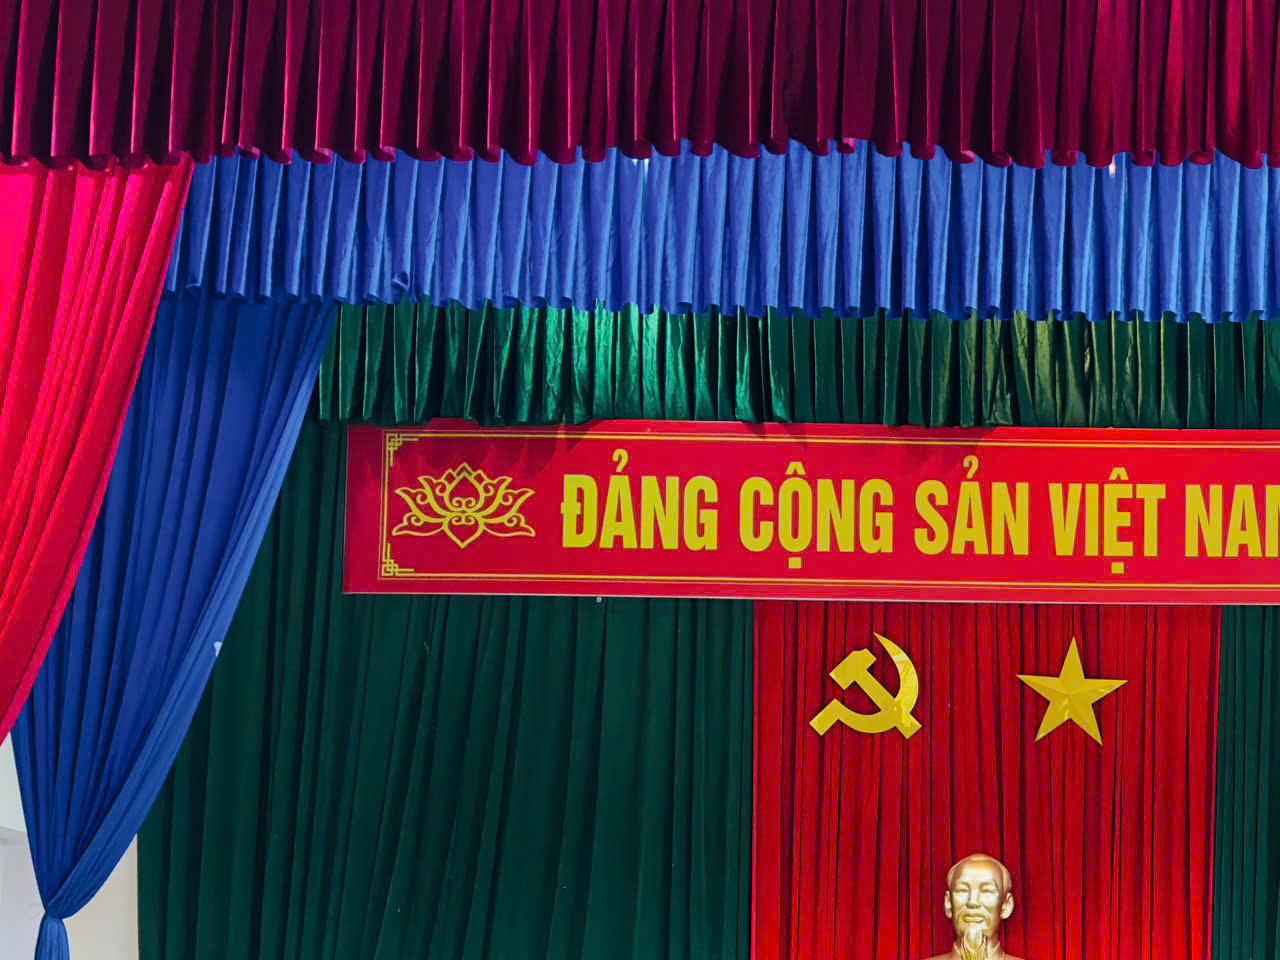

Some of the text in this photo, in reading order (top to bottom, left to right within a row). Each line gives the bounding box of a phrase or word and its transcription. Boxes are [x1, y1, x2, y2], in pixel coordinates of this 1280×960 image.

[561, 449, 718, 551] ĐẢNG
[740, 462, 893, 568] CỘNG
[914, 455, 1029, 555] SẢN
[1048, 467, 1166, 574] VIỆT
